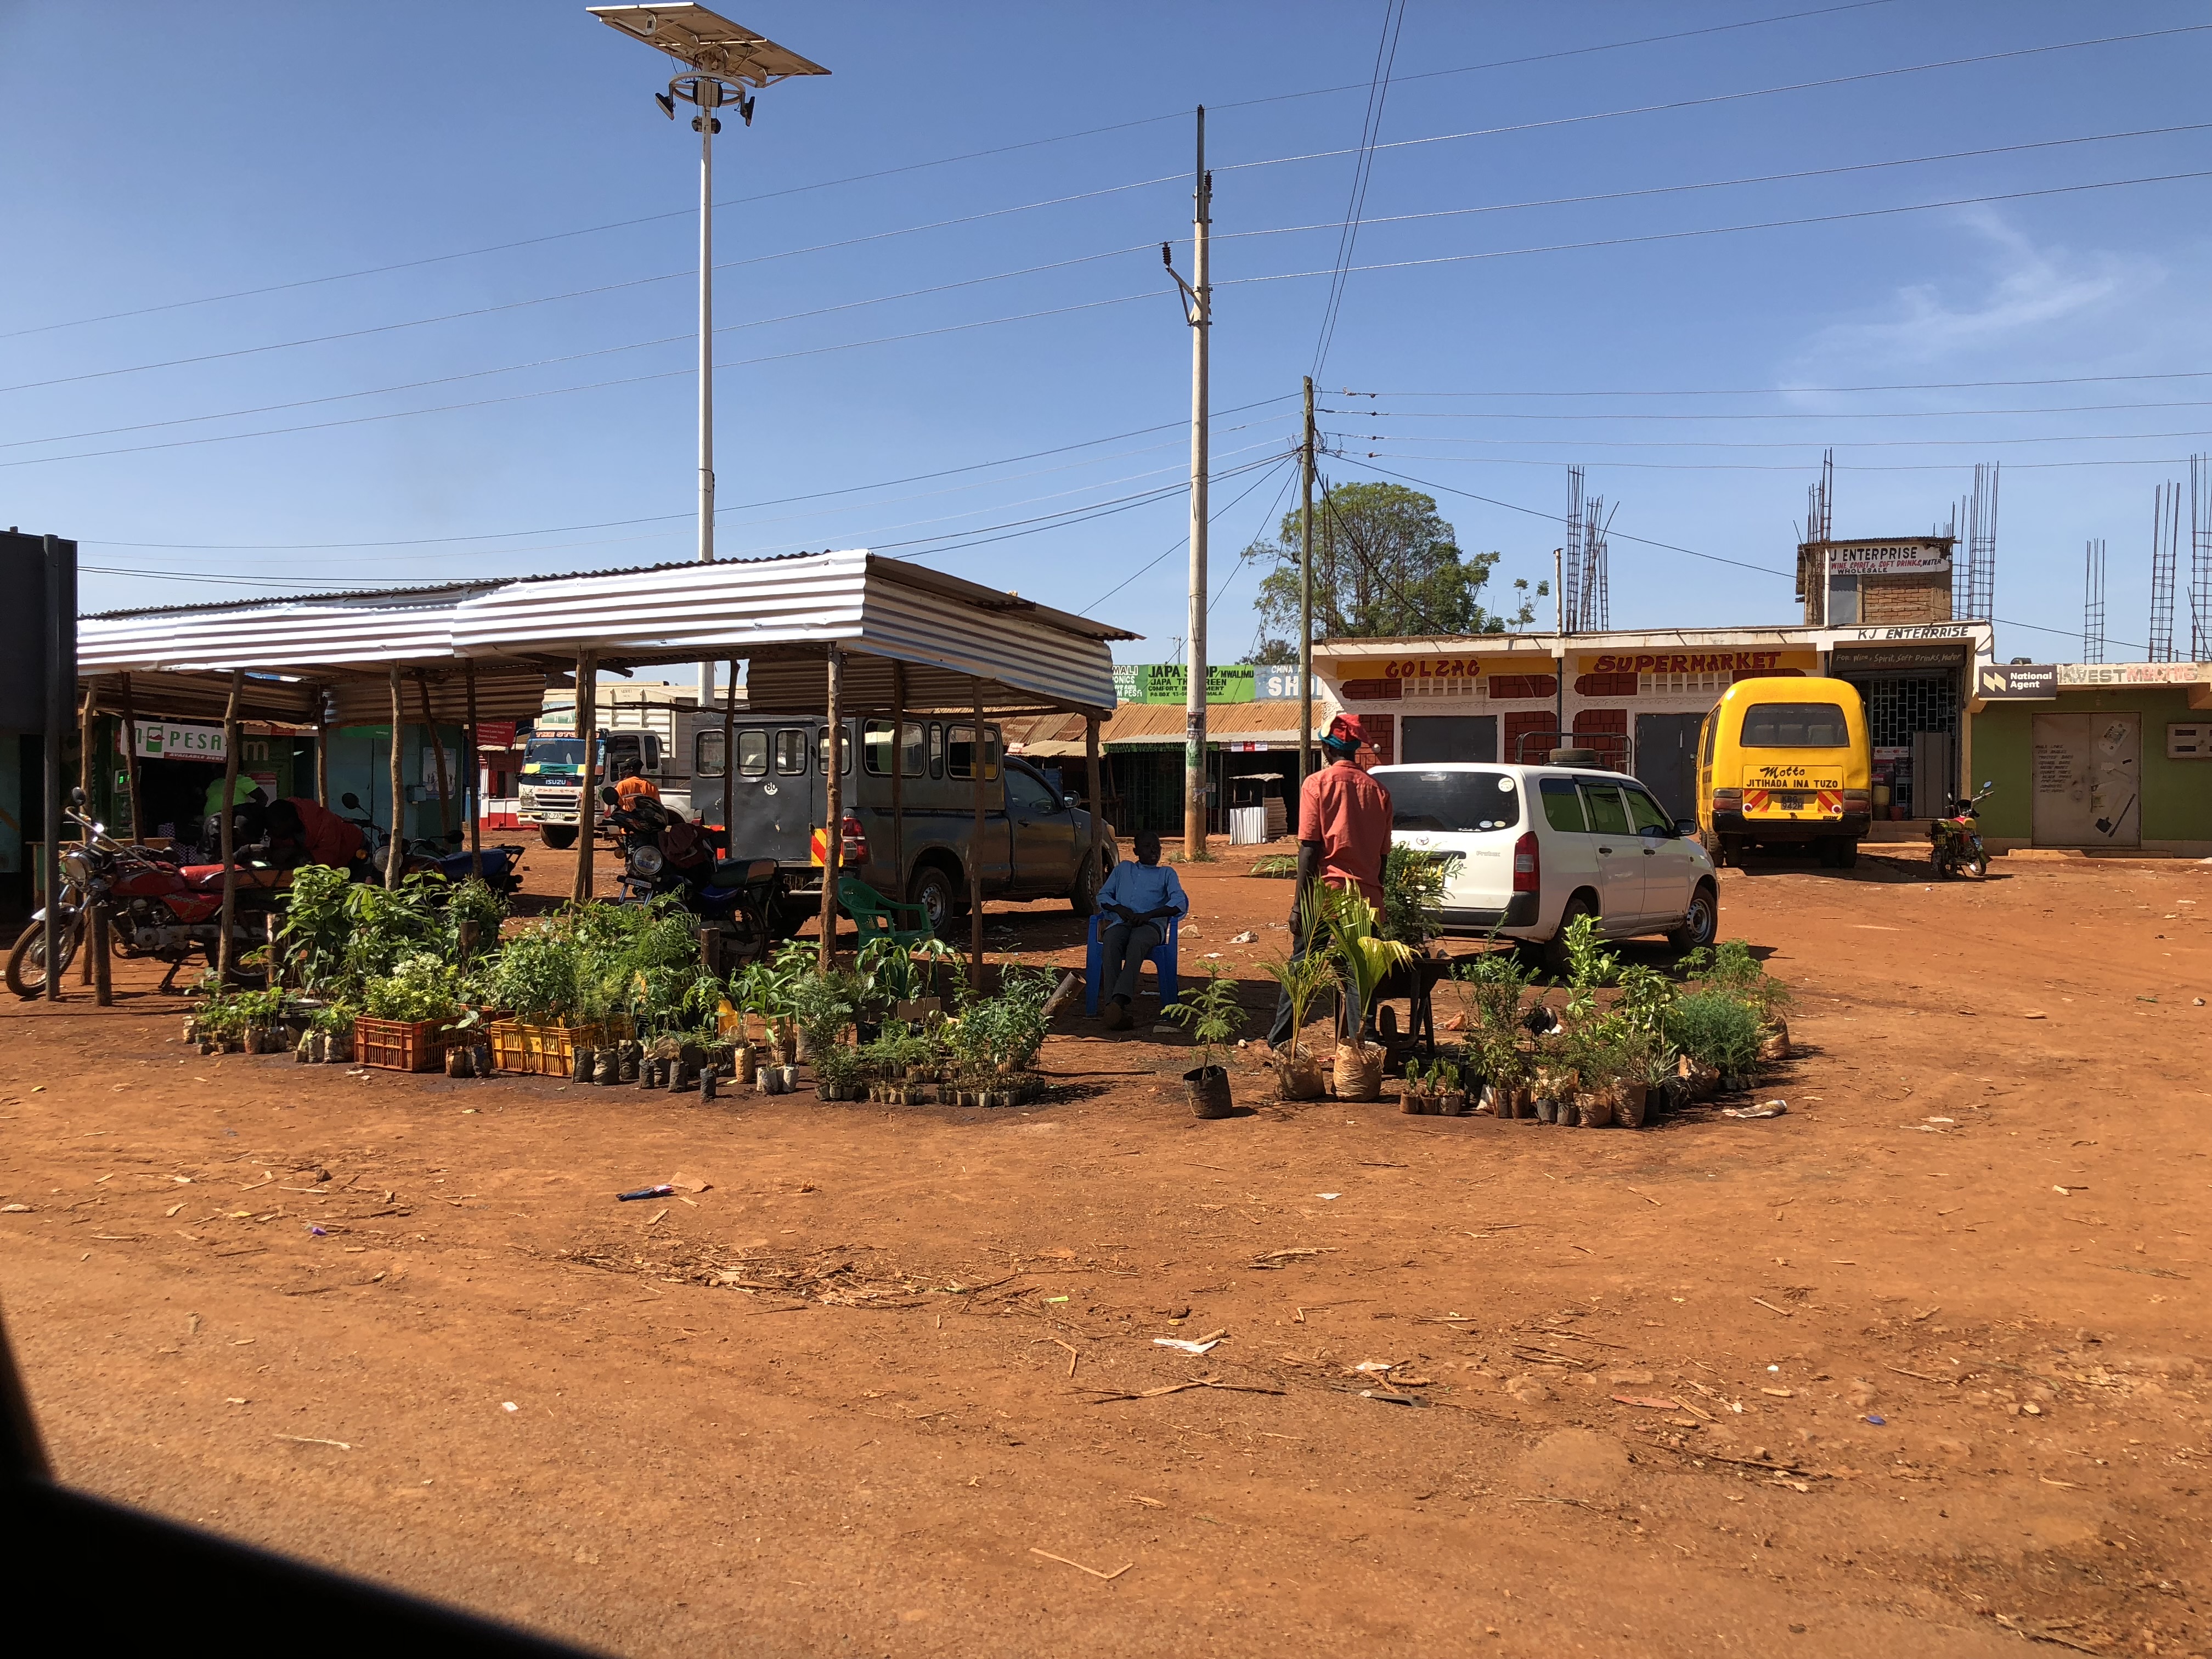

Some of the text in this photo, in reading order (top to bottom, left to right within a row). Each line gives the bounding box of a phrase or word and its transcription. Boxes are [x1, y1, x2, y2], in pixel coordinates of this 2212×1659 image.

[1843, 547, 1918, 562] ENTERPRISE
[1858, 629, 1877, 640] KJ
[1594, 652, 1781, 673] SUPERMARKET
[1148, 665, 1180, 678] JAPA
[1271, 665, 1293, 674] CHINA
[1113, 675, 1135, 684] ONICS
[2010, 672, 2052, 680] National
[2010, 680, 2040, 690] Agent
[170, 730, 222, 751] PESA
[169, 752, 204, 760] AVAILABLE
[1759, 766, 1805, 779] Motto
[1746, 779, 1838, 788] JITIHADA INA TUZO
